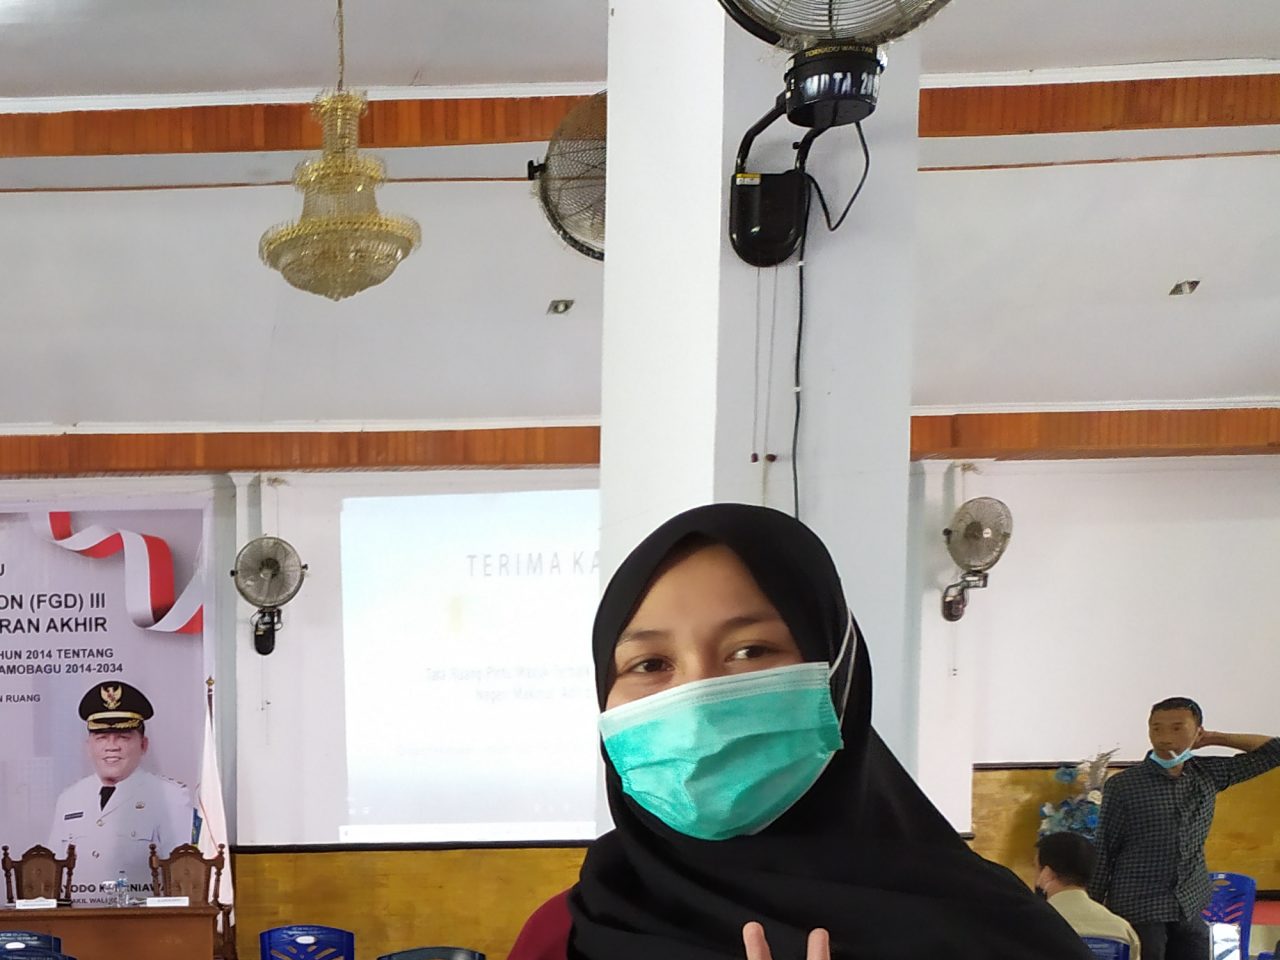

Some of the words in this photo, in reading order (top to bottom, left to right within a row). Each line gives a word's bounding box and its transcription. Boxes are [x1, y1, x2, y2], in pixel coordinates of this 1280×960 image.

[466, 552, 562, 577] TERIMA
[572, 551, 600, 575] KA
[29, 593, 84, 613] (FGD)
[89, 593, 106, 609] III
[45, 617, 108, 633] AKHIR
[25, 649, 53, 660] 2014
[56, 648, 114, 660] TENTANG
[65, 663, 123, 674] 2014-2034
[5, 694, 41, 703] RUANG
